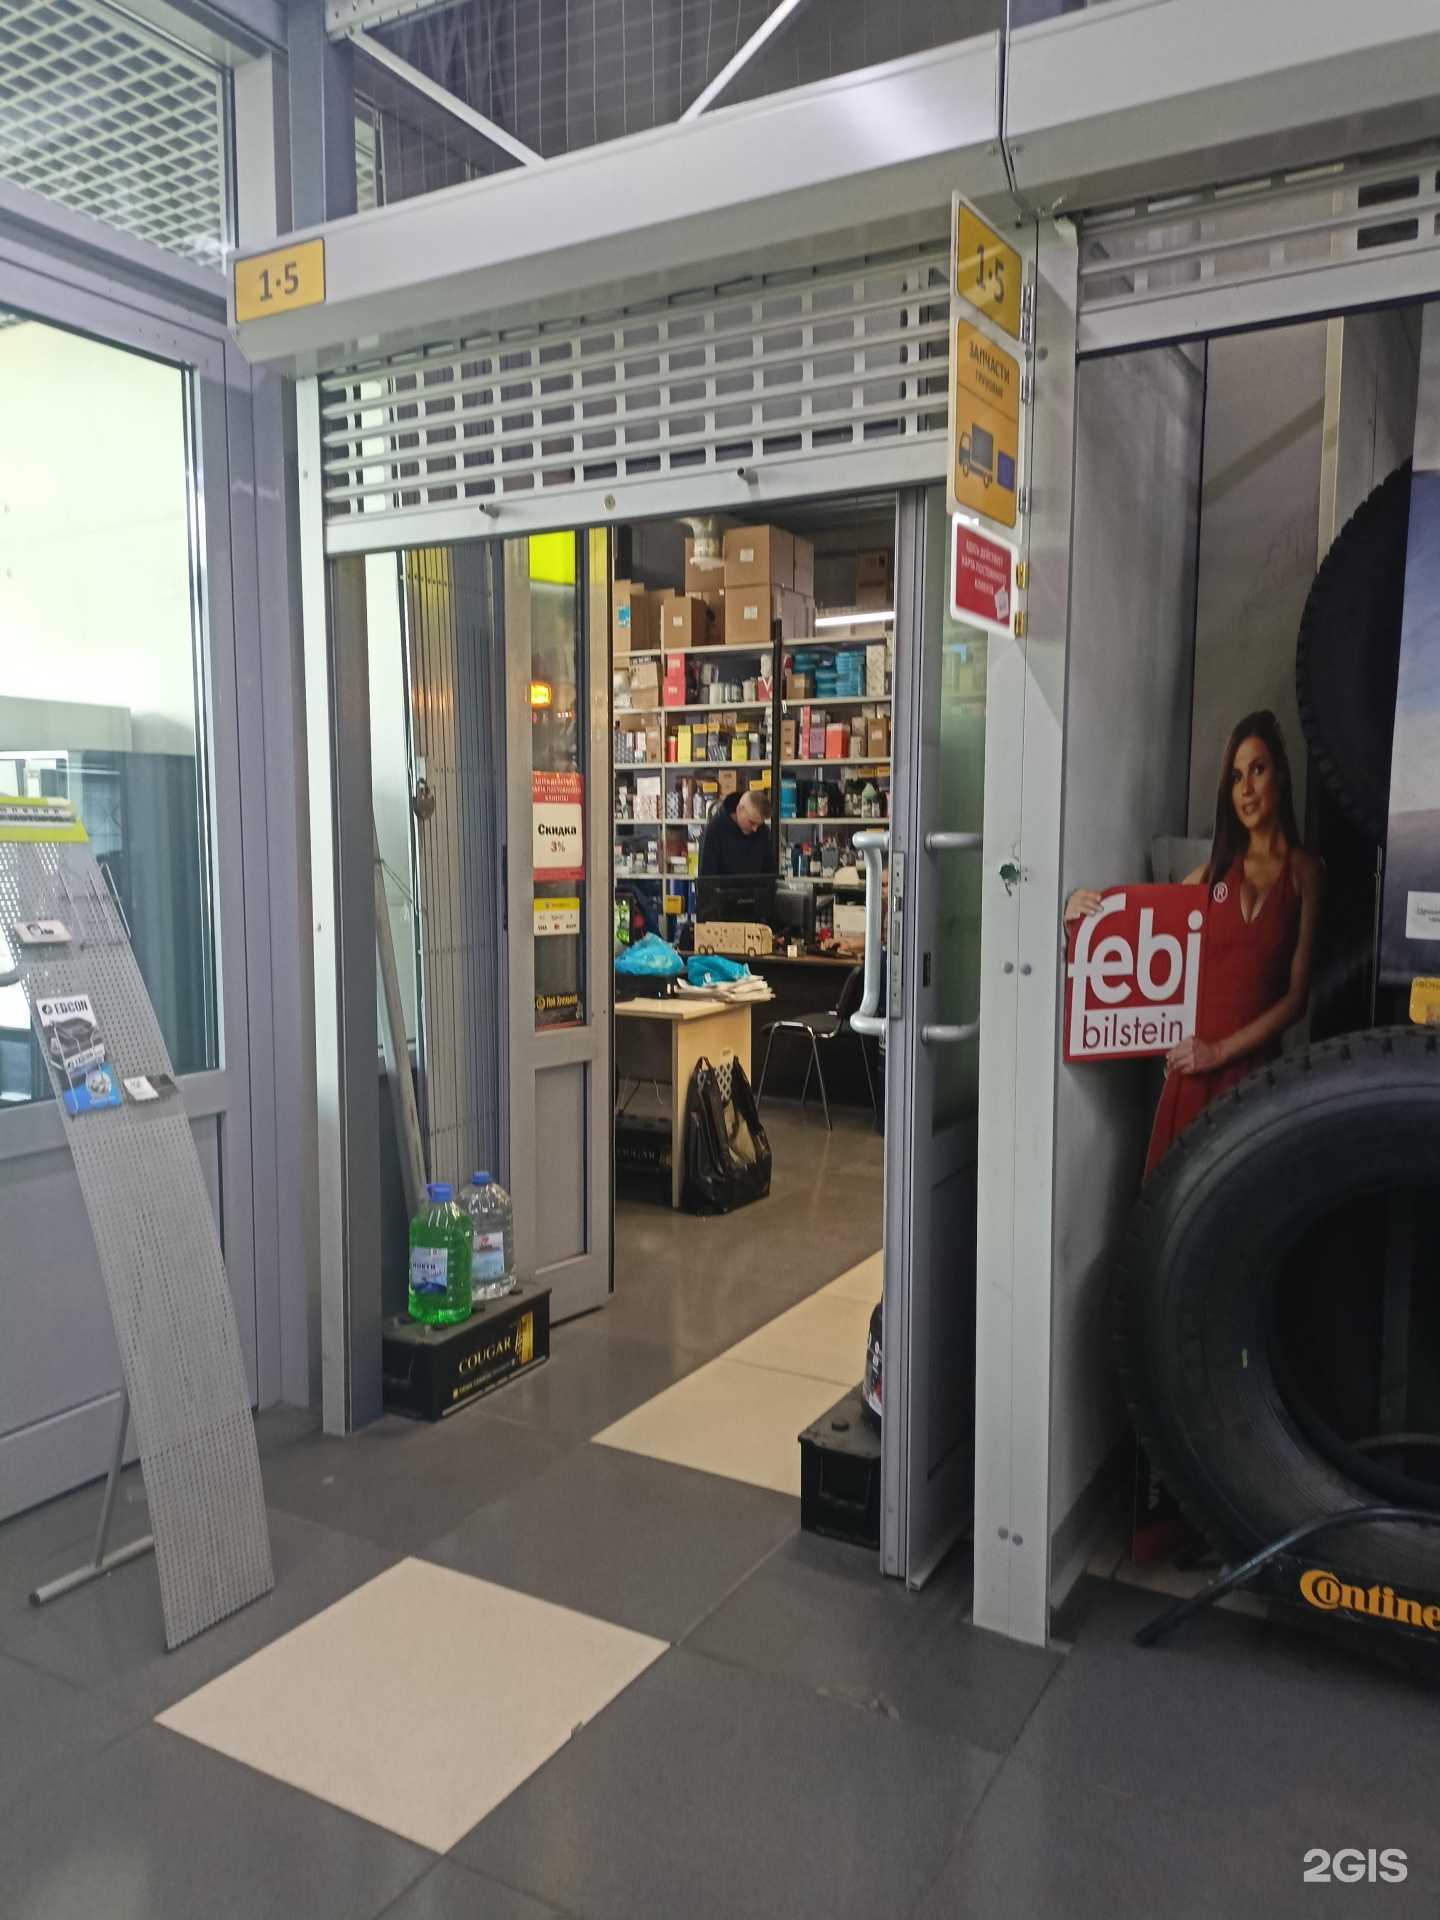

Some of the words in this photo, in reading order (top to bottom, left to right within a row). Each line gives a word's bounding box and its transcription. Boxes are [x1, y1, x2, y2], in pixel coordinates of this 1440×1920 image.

[969, 341, 1010, 385] ЗАПЧАСТИ
[538, 824, 577, 836] Скидка
[551, 842, 565, 852] 3%
[1082, 1012, 1183, 1049] bilstein
[458, 1337, 511, 1374] COUGAR
